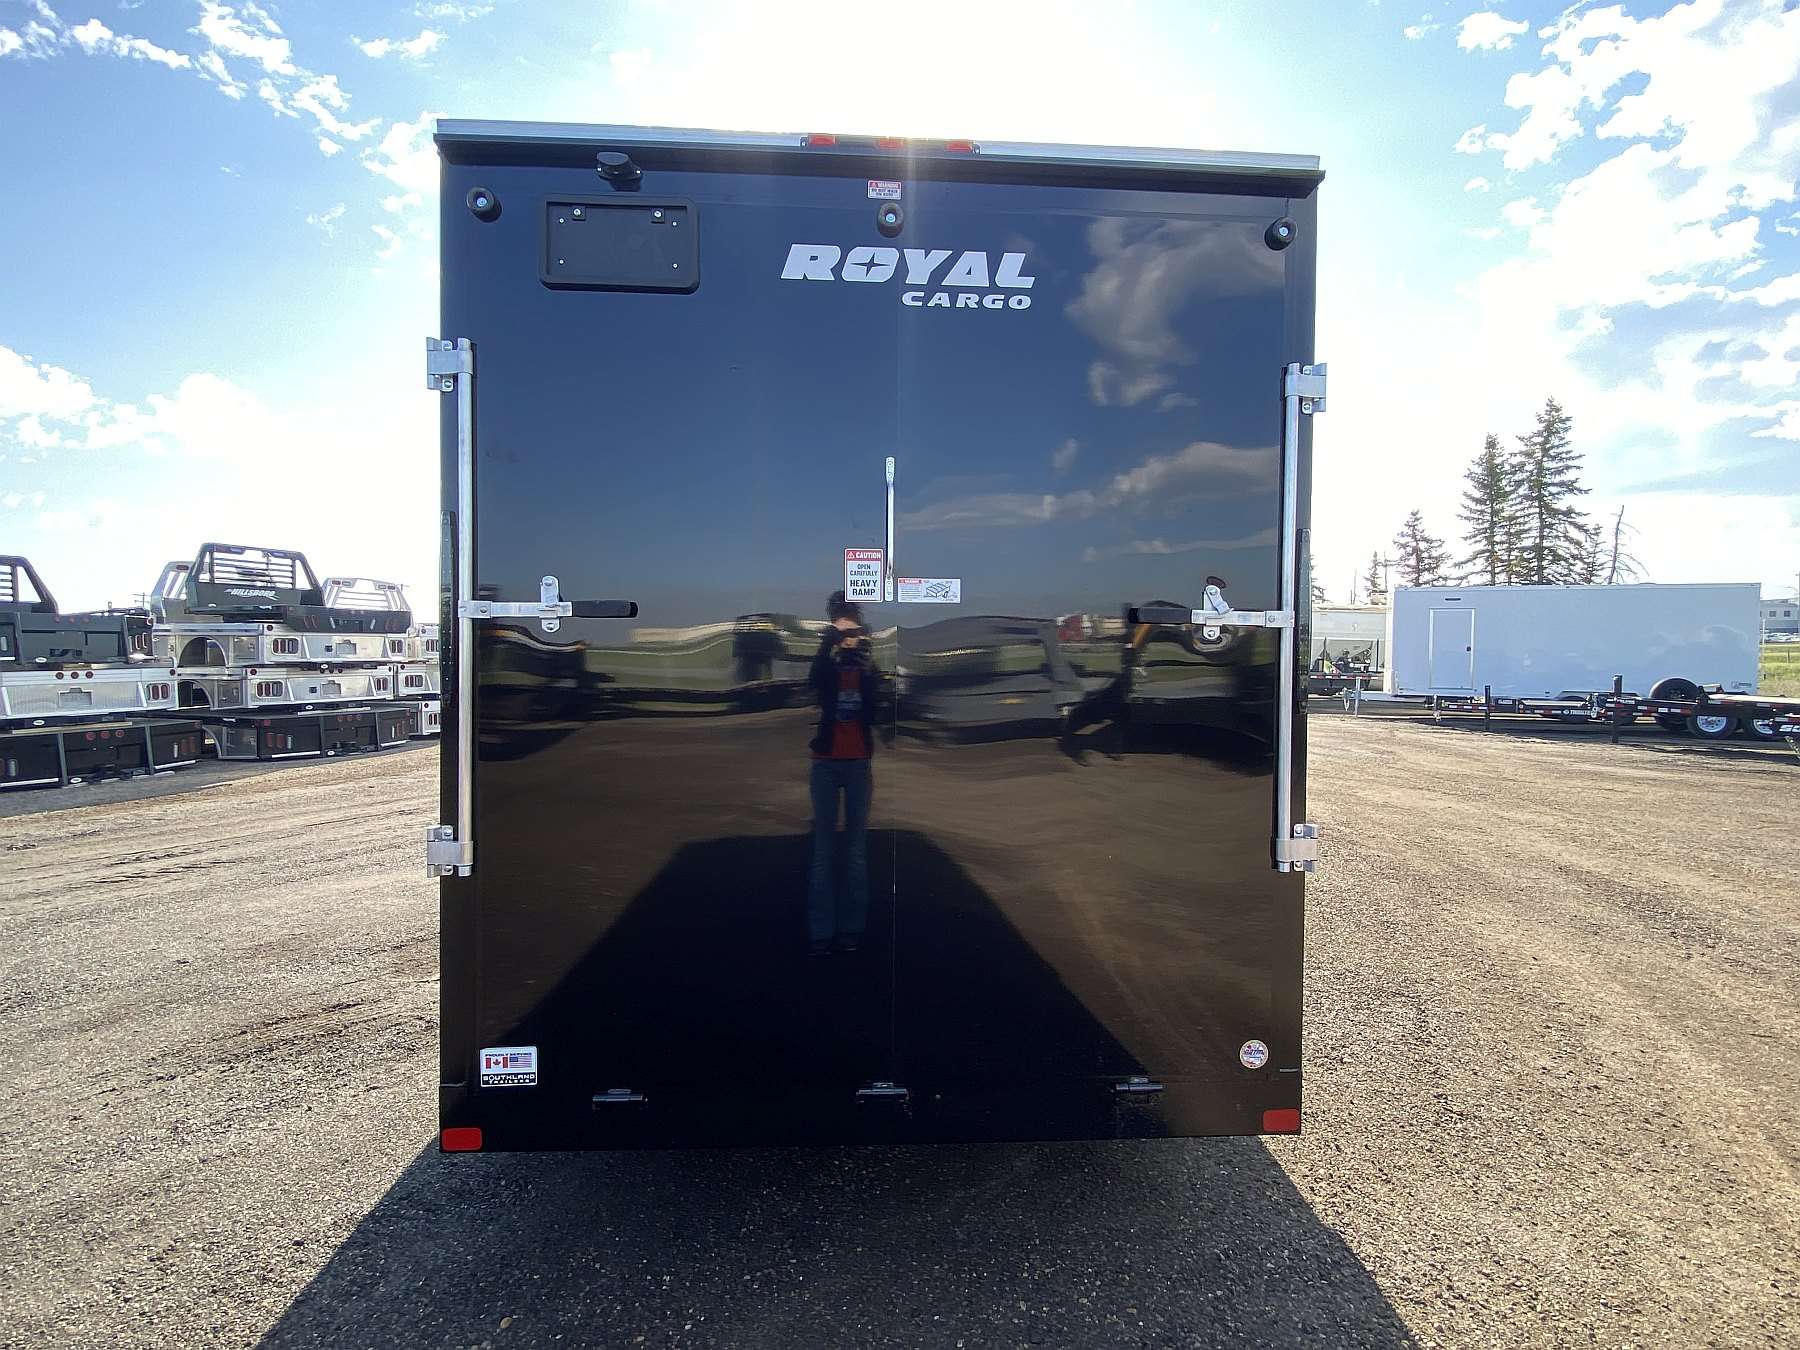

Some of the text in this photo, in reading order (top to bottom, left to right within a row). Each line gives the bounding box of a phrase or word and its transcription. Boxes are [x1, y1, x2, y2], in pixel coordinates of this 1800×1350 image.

[780, 243, 1036, 289] ROYAL
[902, 291, 1032, 310] CARGO
[855, 551, 881, 559] CAUTION
[850, 579, 878, 587] HEAVY
[852, 588, 876, 596] RAMP
